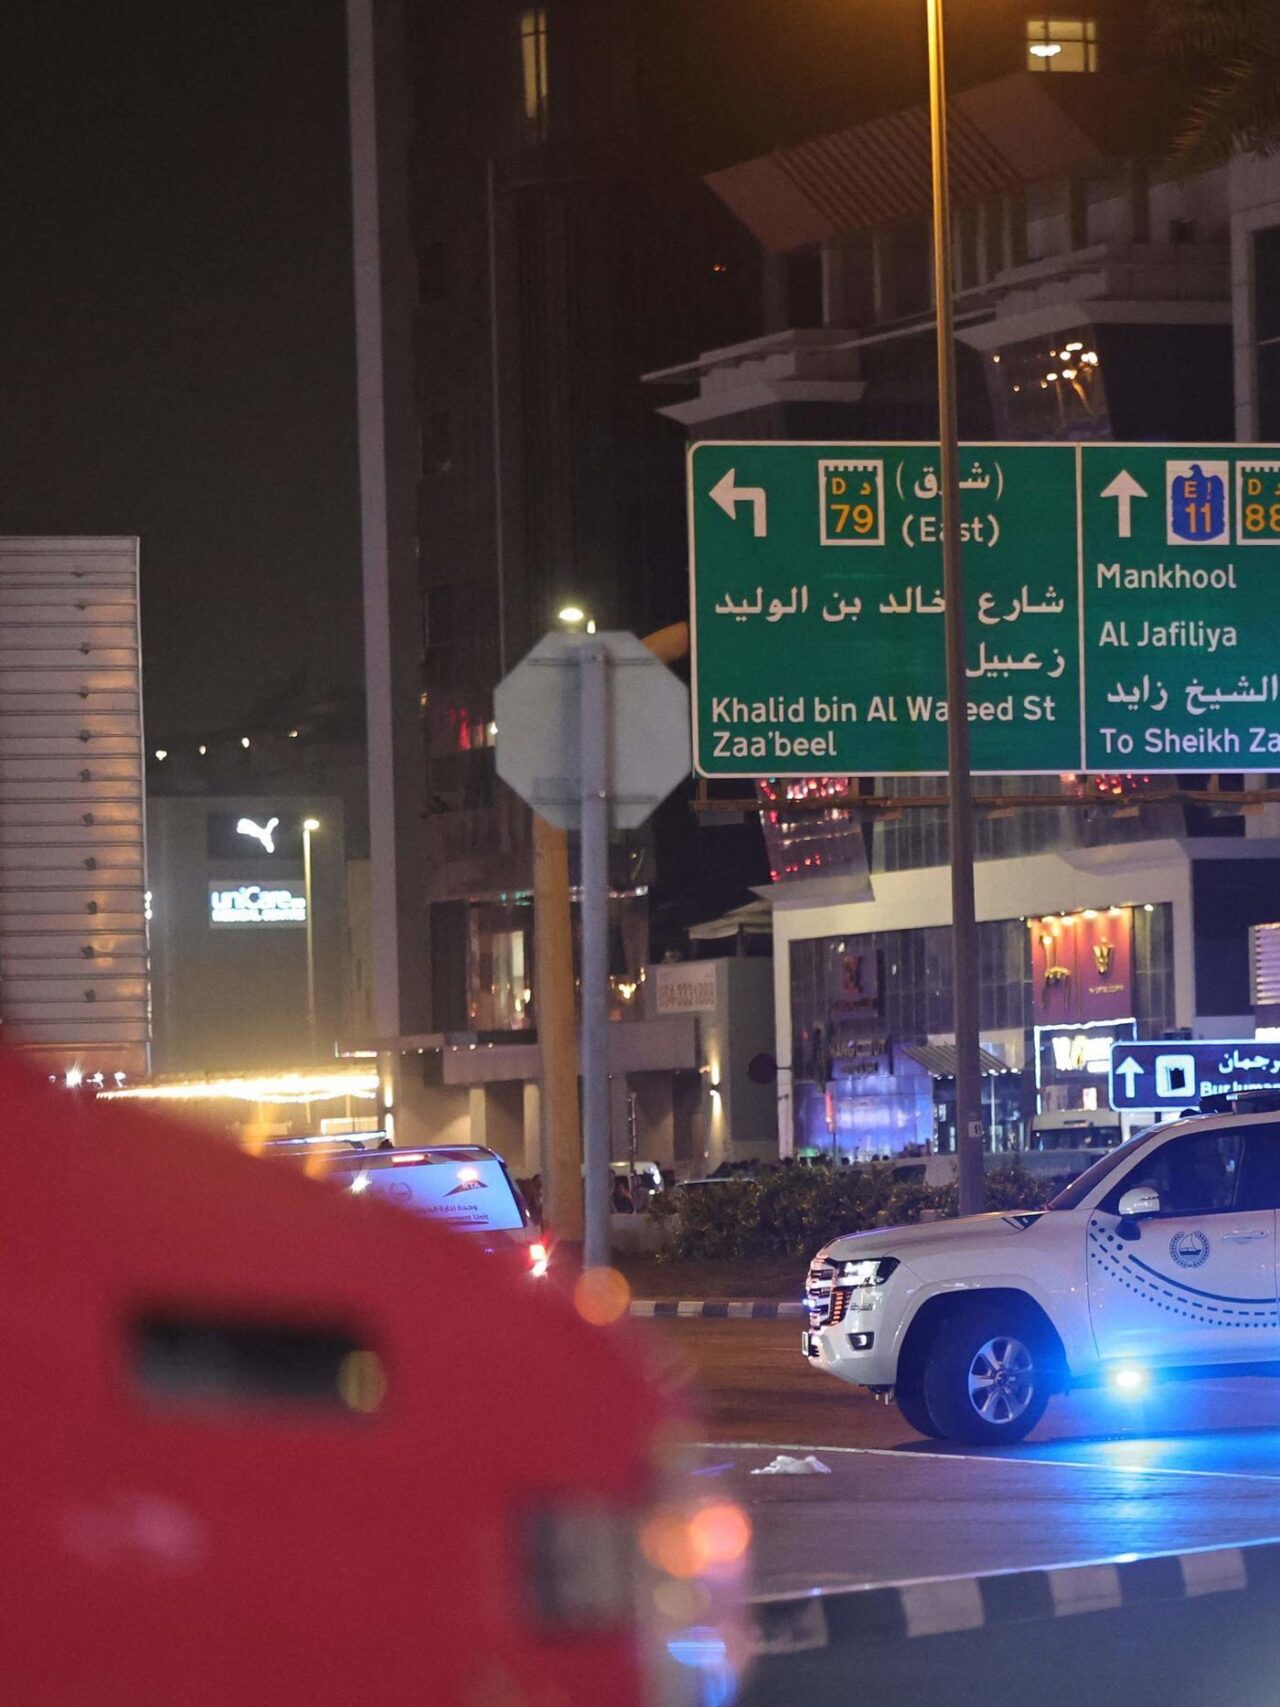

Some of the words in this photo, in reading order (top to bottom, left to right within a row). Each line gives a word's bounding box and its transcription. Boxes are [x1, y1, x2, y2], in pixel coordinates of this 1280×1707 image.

[896, 461, 1003, 501] (شق)
[830, 504, 874, 534] 79
[902, 514, 999, 548] (Est)
[1185, 503, 1212, 533] 11
[1097, 563, 1237, 589] Mankhool
[715, 585, 809, 622] الوليد
[822, 592, 862, 622] بن
[878, 586, 945, 615] خالد
[977, 585, 1064, 625] شارع
[1099, 621, 1129, 647] Al
[1137, 620, 1237, 652] Jafiliya
[964, 641, 1066, 678] زعبيل
[1107, 674, 1168, 711] زايد
[1185, 674, 1278, 715] الشيخ
[712, 696, 805, 723] Khalid
[814, 696, 857, 723] bin
[867, 696, 898, 722] Al
[906, 696, 1014, 722] Waeed
[1023, 695, 1056, 721] St
[1099, 728, 1134, 754] To
[1144, 727, 1240, 753] Sheikh
